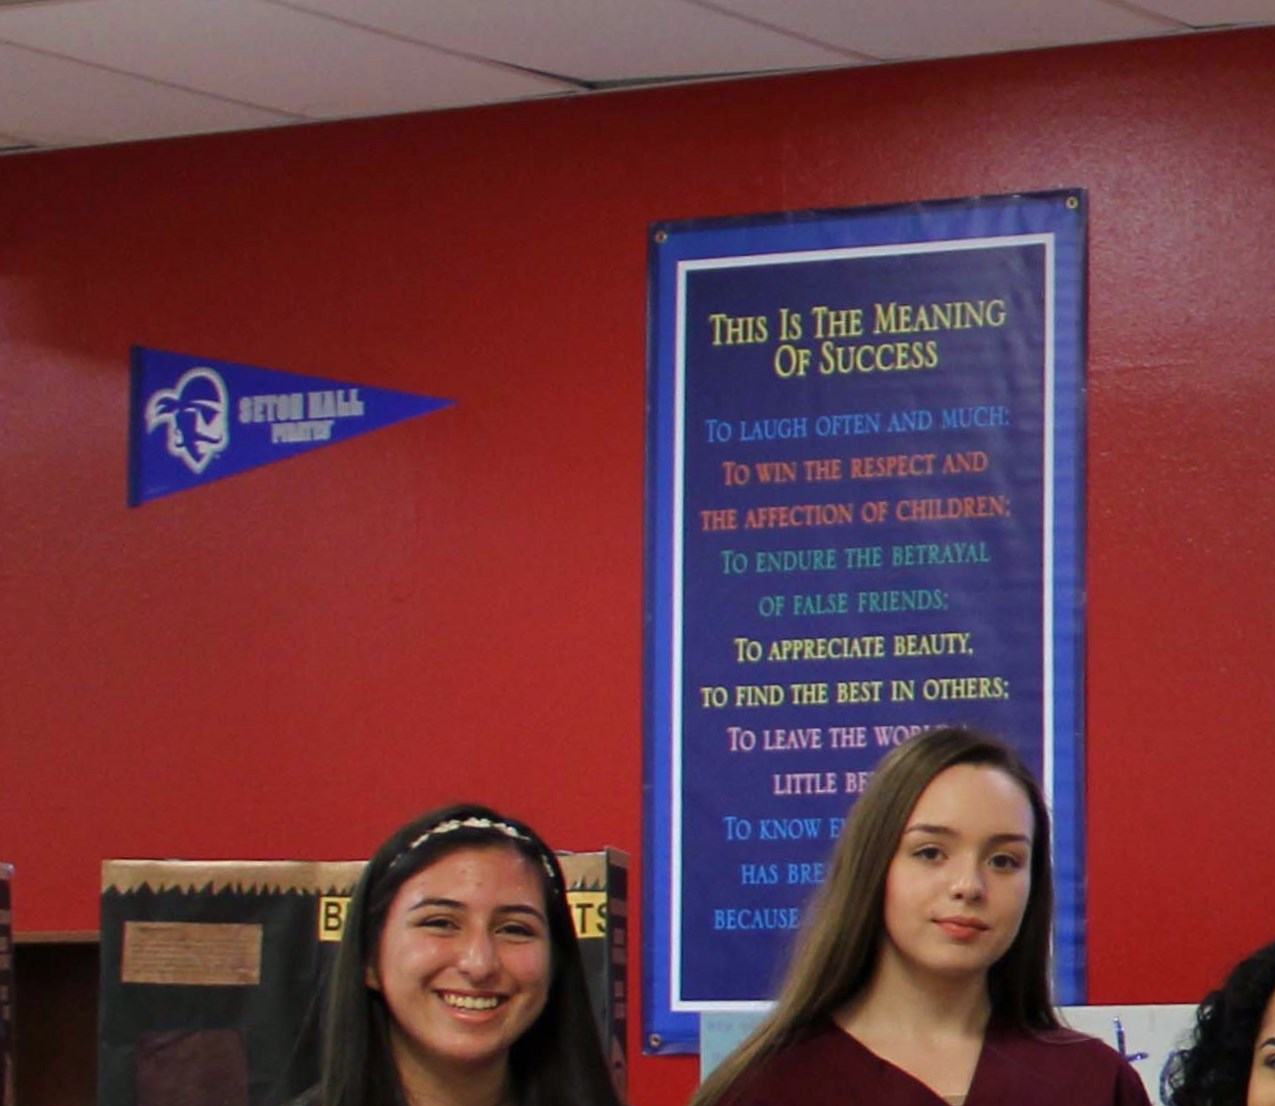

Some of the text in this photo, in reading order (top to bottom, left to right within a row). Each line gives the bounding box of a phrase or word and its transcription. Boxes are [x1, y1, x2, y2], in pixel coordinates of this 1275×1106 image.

[709, 300, 1007, 345] THIS IS THE MEANING
[774, 341, 938, 378] OF SUCCESS
[705, 419, 732, 443] TO
[740, 417, 808, 441] LAUGH
[815, 412, 881, 436] OFTEN
[887, 410, 932, 433] AND
[722, 451, 988, 486] TO WIN THE RESPECT AND
[702, 510, 737, 531] THE
[744, 503, 853, 529] AFFECTION
[861, 501, 888, 523] OF
[721, 542, 990, 574] TO ENDURE THE BETRAYAL
[759, 596, 784, 617] OF
[793, 593, 848, 615] FALSE
[735, 637, 762, 662] TO
[768, 636, 886, 661] APPRECIATE
[701, 677, 1009, 707] TO FIND THE BEST IN OTHERS;
[726, 727, 756, 751] TO
[763, 728, 823, 749] LEAVE
[829, 727, 867, 747] THE
[772, 773, 838, 795] LITTLE
[723, 816, 752, 841] TO
[759, 818, 822, 839] KNOW
[741, 864, 778, 884] HAS
[713, 909, 800, 930] BECAUSE
